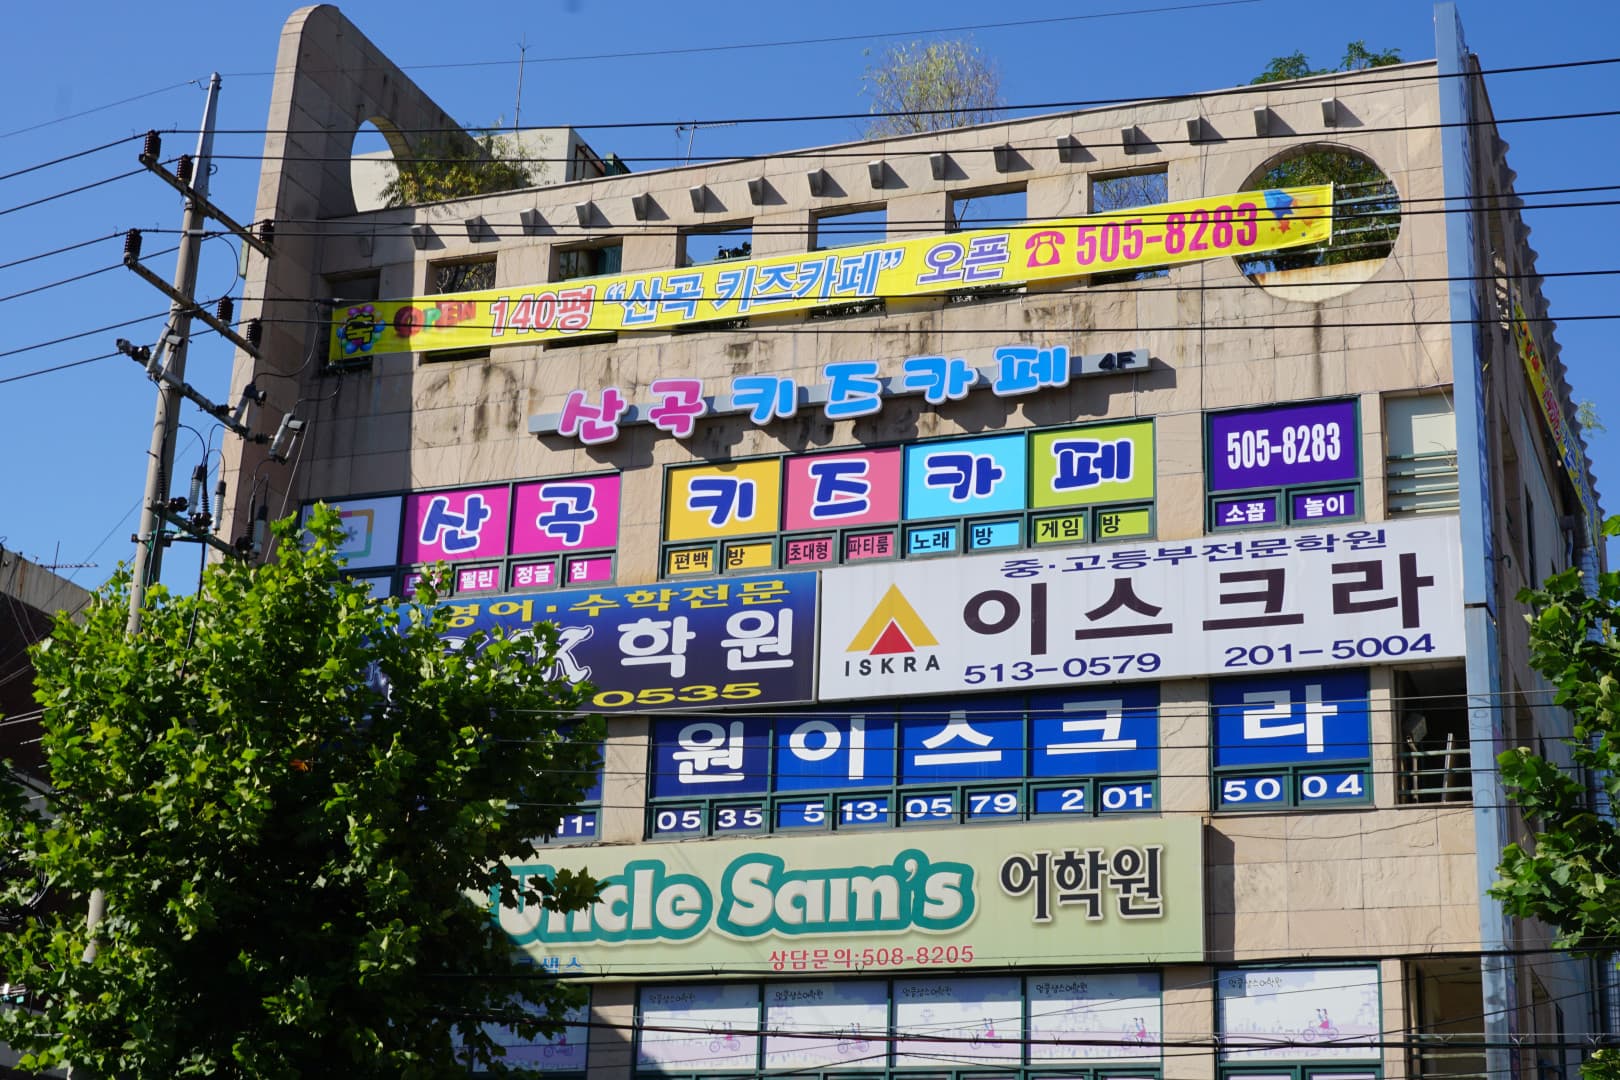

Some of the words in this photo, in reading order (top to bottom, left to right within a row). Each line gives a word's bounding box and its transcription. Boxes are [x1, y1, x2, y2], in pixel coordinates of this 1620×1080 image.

[394, 299, 476, 338] OPEN
[490, 285, 595, 337] 140평
[917, 233, 1010, 285] 오픈
[1077, 202, 1258, 266] 505-8283
[1099, 351, 1136, 370] 4F
[1227, 422, 1341, 470] 505-8283
[789, 541, 828, 561] 초대형
[849, 536, 889, 554] 파티룸
[963, 552, 1434, 656] 이스크라
[617, 607, 794, 679] 학원
[845, 654, 940, 677] ISKRA
[964, 652, 1161, 685] 513-0579
[1224, 633, 1435, 667] 201-5004
[592, 682, 763, 708] 0535
[727, 858, 963, 925] Sam's
[1000, 844, 1163, 922] 어학원
